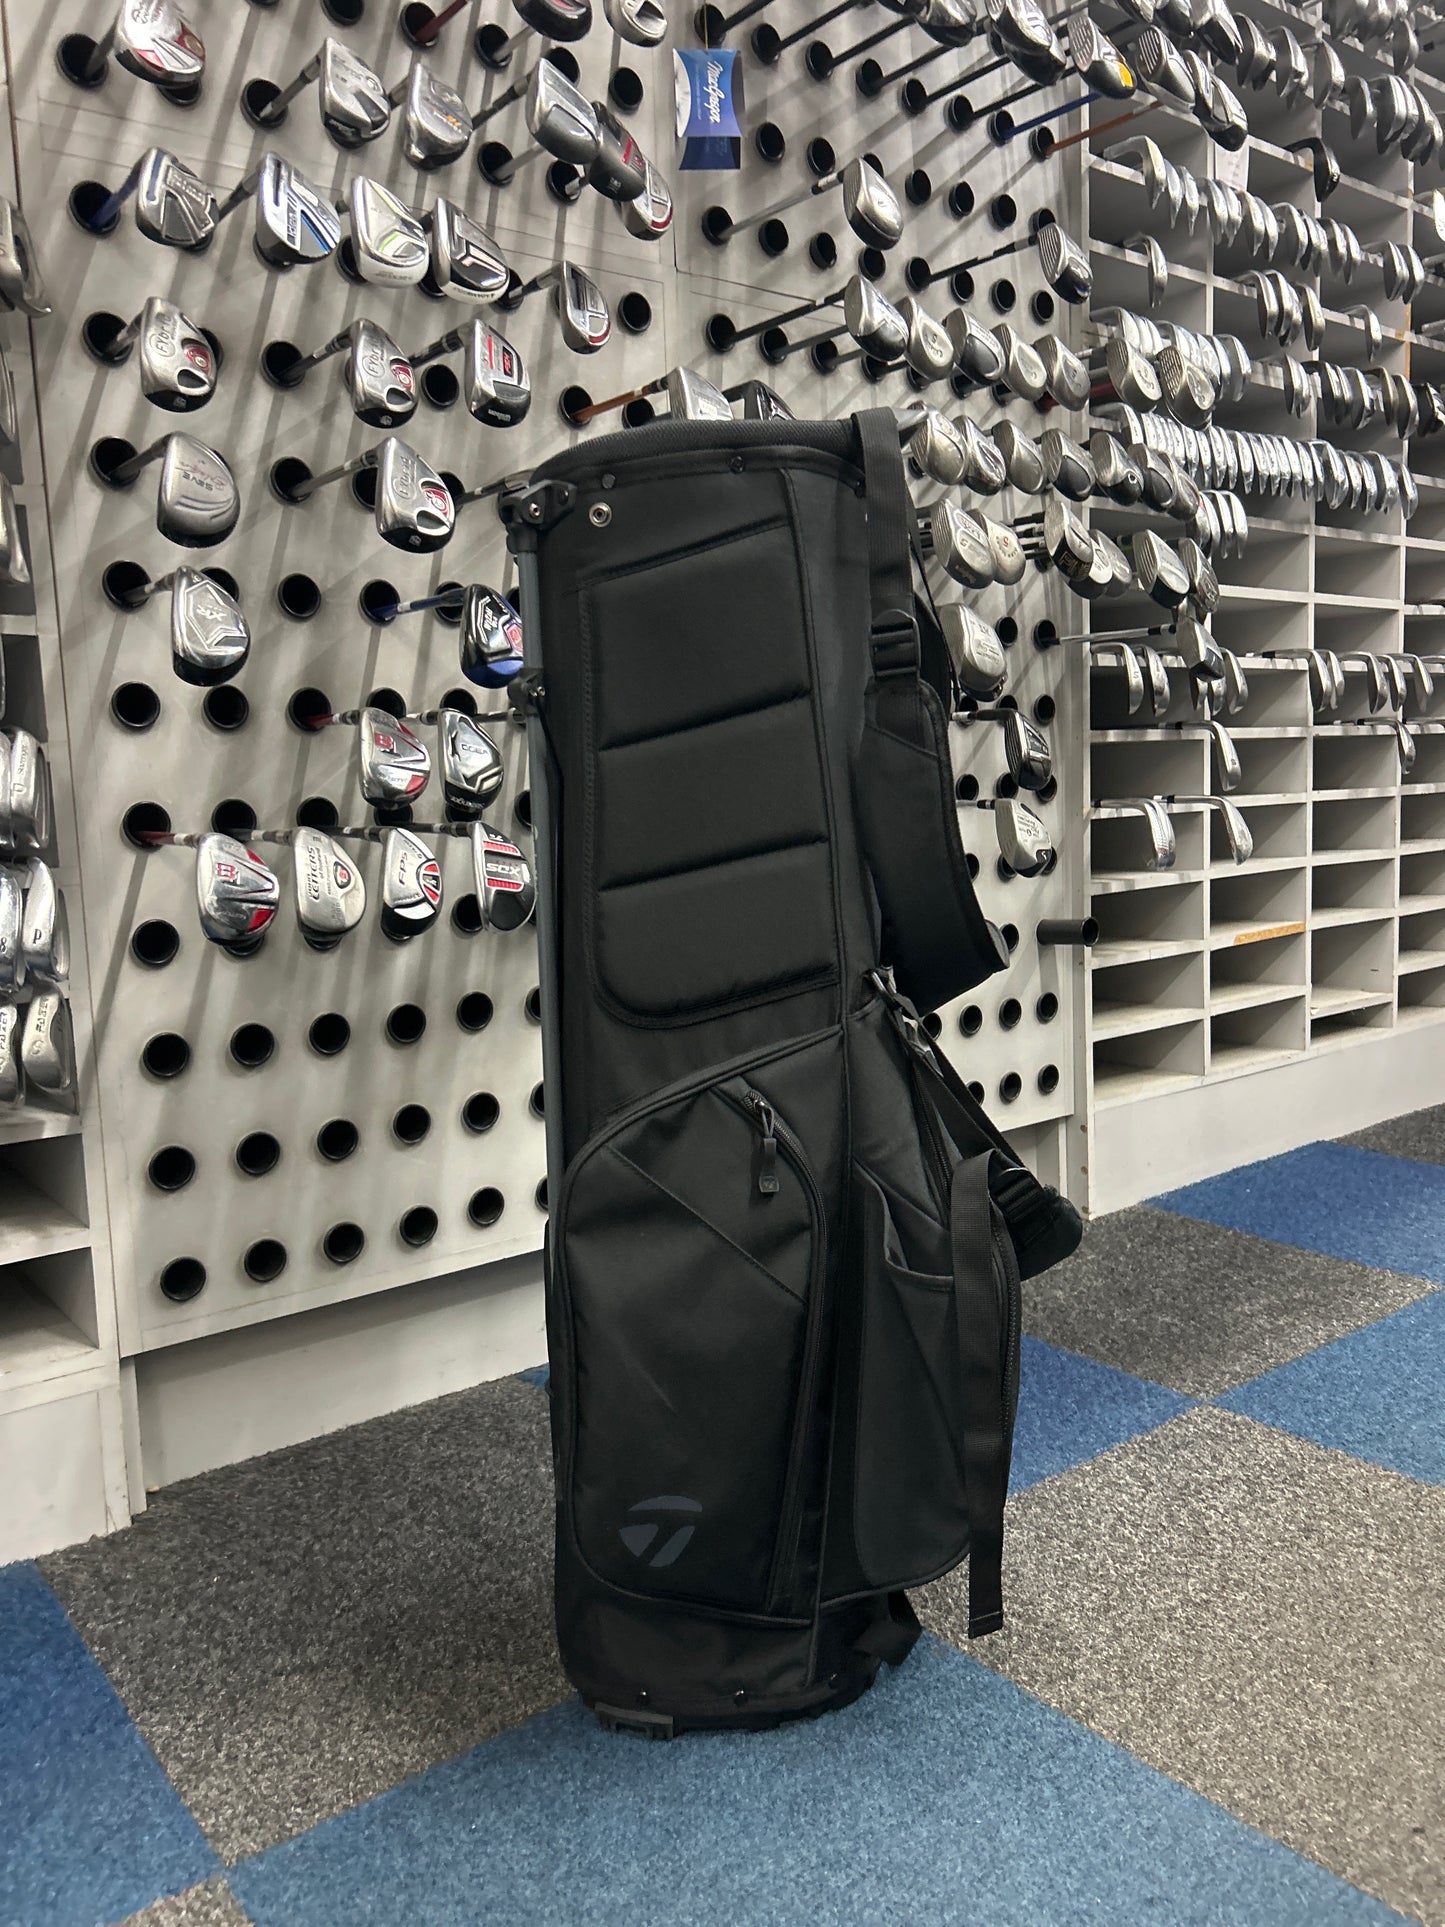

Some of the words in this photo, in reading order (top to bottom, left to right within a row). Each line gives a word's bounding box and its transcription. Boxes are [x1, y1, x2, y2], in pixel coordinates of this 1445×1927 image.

[703, 61, 725, 124] MacGregor
[308, 846, 320, 901] LETTERS
[32, 928, 42, 945] P
